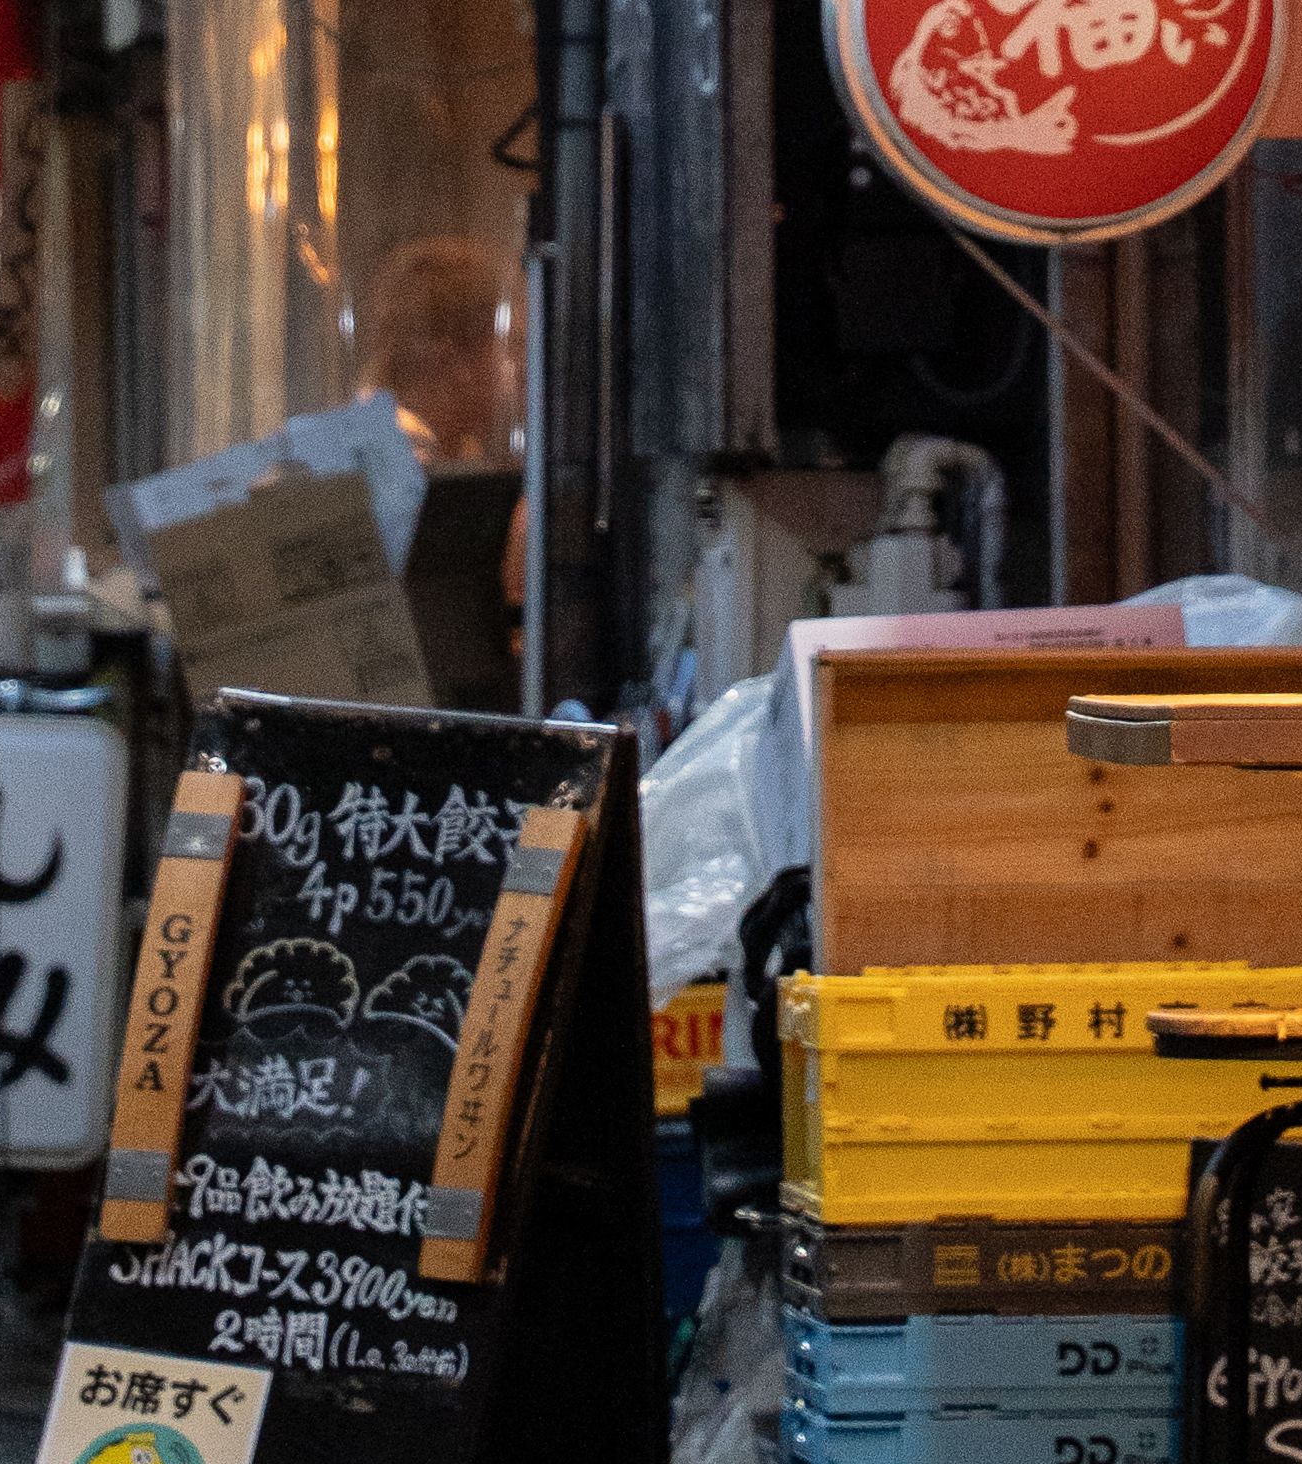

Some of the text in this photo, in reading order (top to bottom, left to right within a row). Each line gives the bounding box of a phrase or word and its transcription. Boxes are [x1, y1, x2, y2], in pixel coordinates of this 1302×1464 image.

[136, 912, 195, 1094] GYOZA
[79, 1364, 246, 1425] お席すぐ
